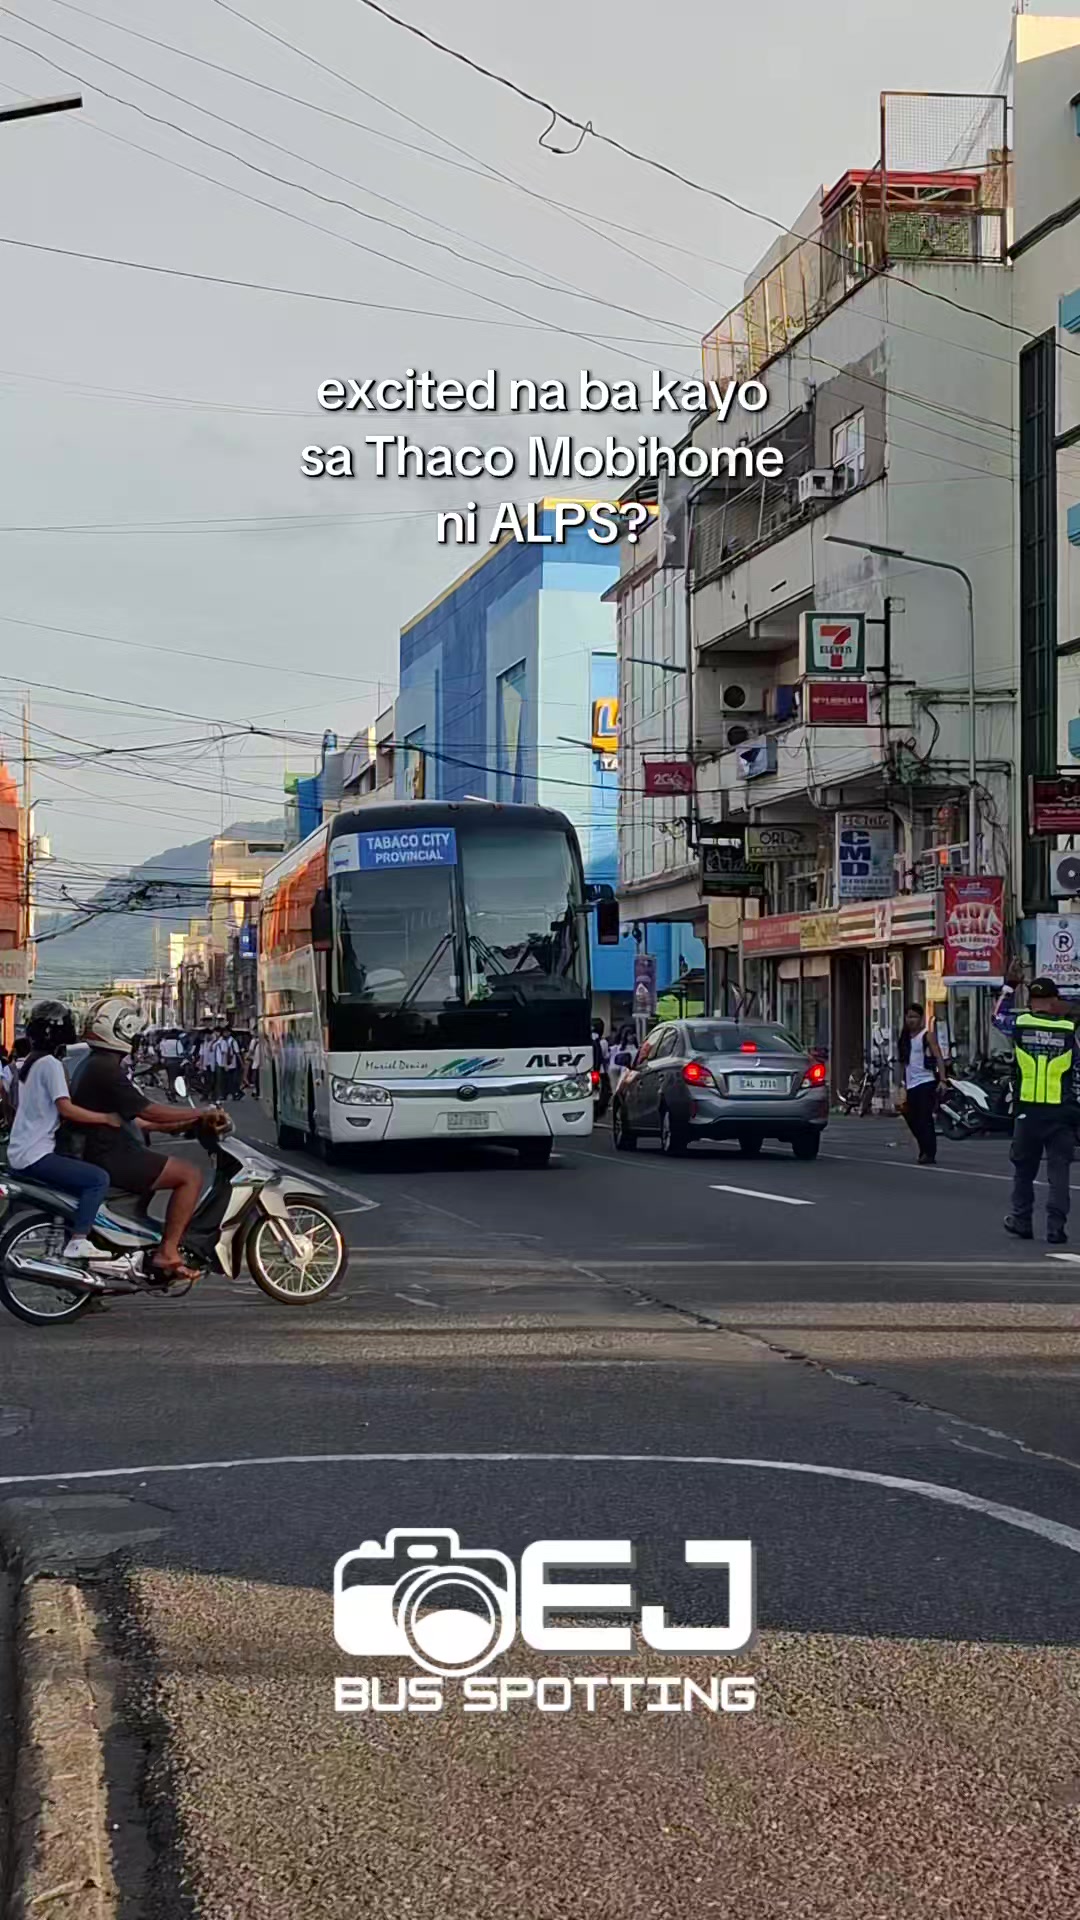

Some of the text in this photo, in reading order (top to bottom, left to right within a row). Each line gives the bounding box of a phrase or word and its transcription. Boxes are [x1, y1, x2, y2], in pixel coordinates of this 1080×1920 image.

[366, 832, 450, 851] TABACO CITY
[375, 849, 444, 864] PROVINCIAL
[525, 1053, 586, 1068] ALPS
